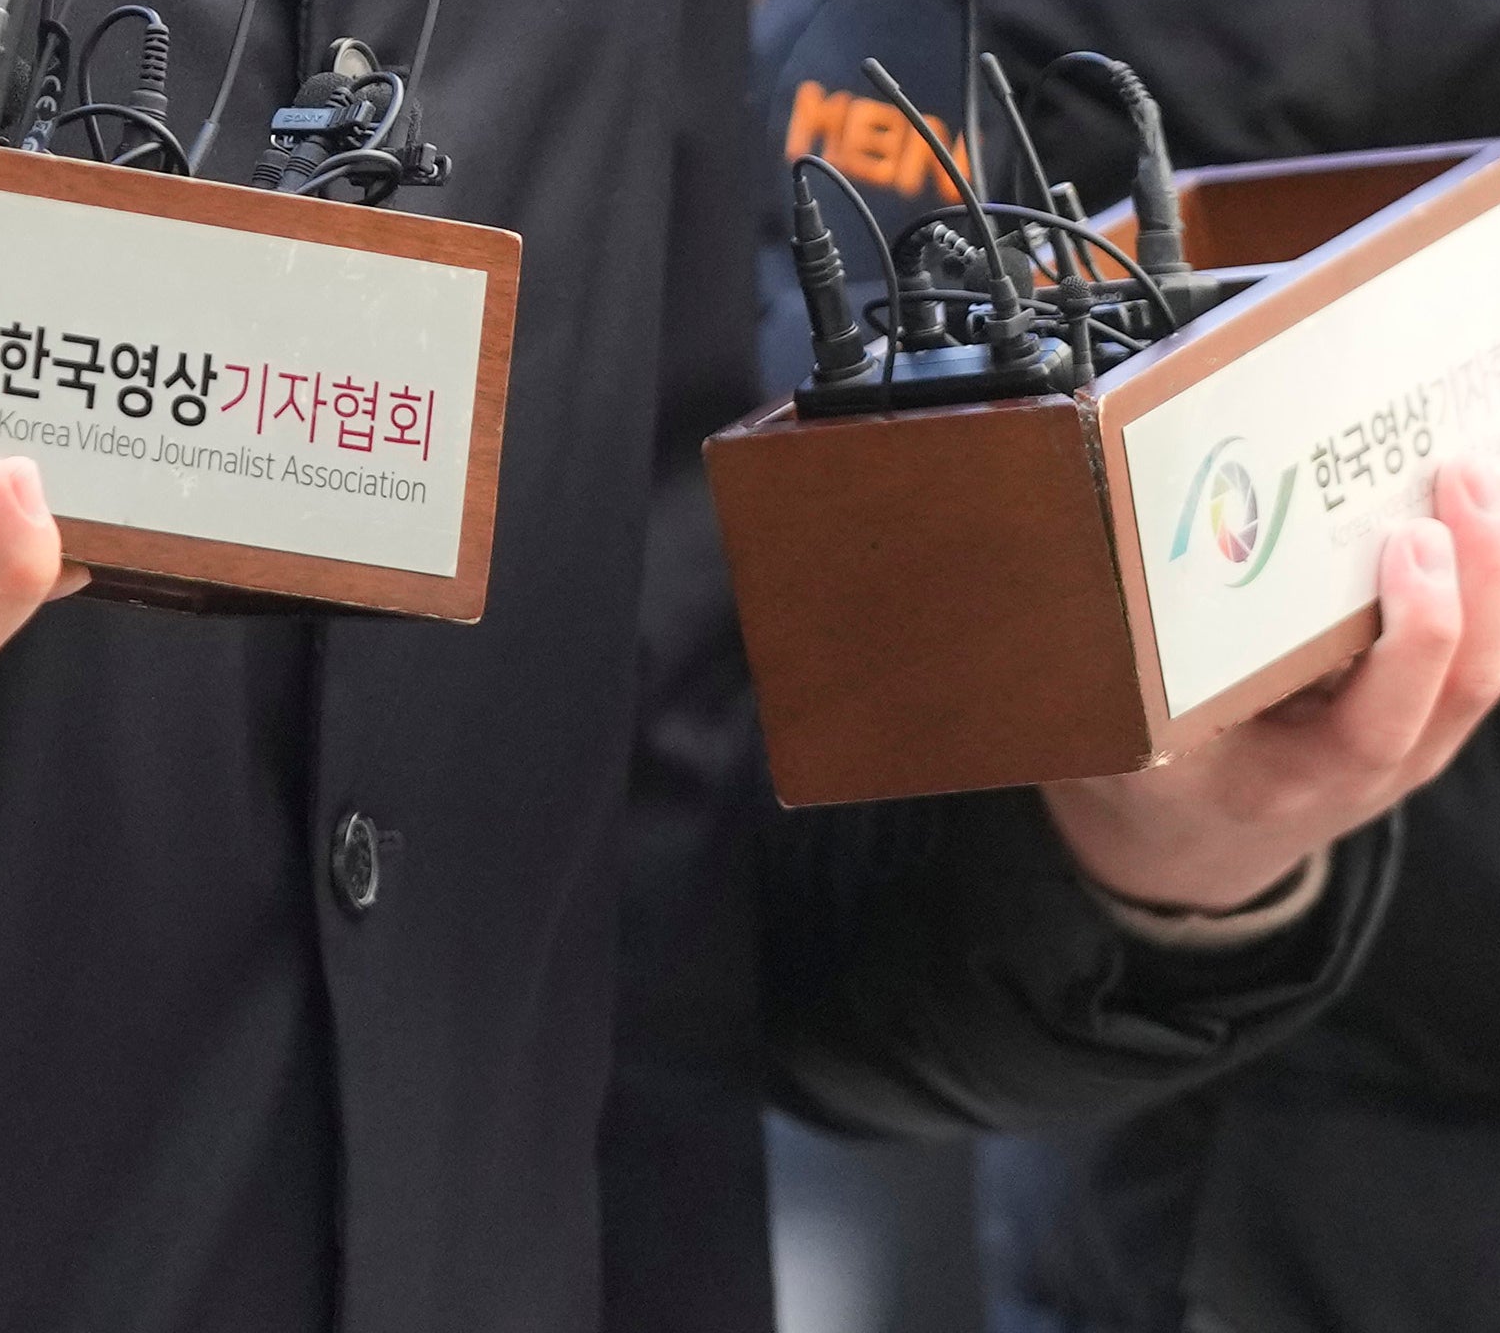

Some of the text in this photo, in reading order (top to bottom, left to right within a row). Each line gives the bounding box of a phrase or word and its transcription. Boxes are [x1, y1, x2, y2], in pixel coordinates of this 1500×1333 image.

[784, 79, 981, 206] MBN
[77, 421, 147, 460] Video
[151, 434, 276, 481] Journalist
[281, 455, 427, 504] Association
